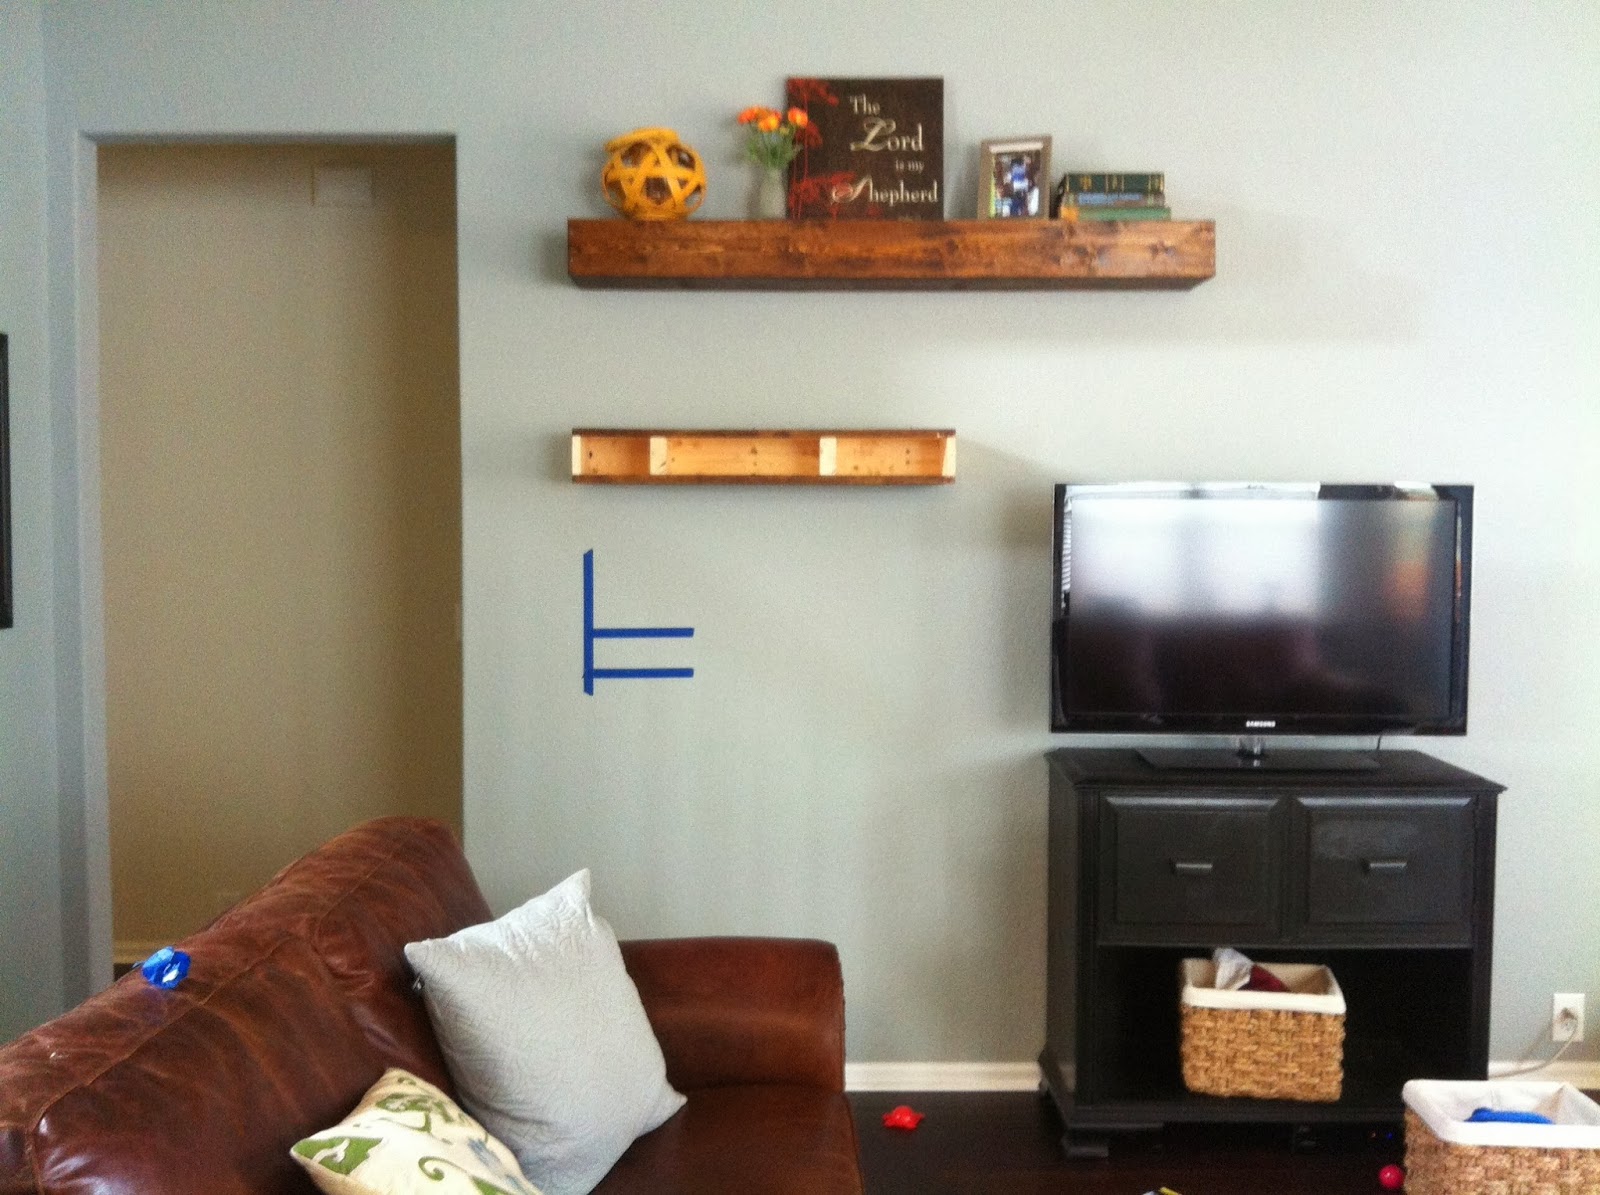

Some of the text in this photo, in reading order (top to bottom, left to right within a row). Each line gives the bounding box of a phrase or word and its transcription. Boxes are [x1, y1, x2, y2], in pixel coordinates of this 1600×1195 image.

[850, 93, 881, 115] The
[850, 116, 923, 152] Lord
[908, 162, 925, 174] my
[831, 174, 938, 207] Shepherd
